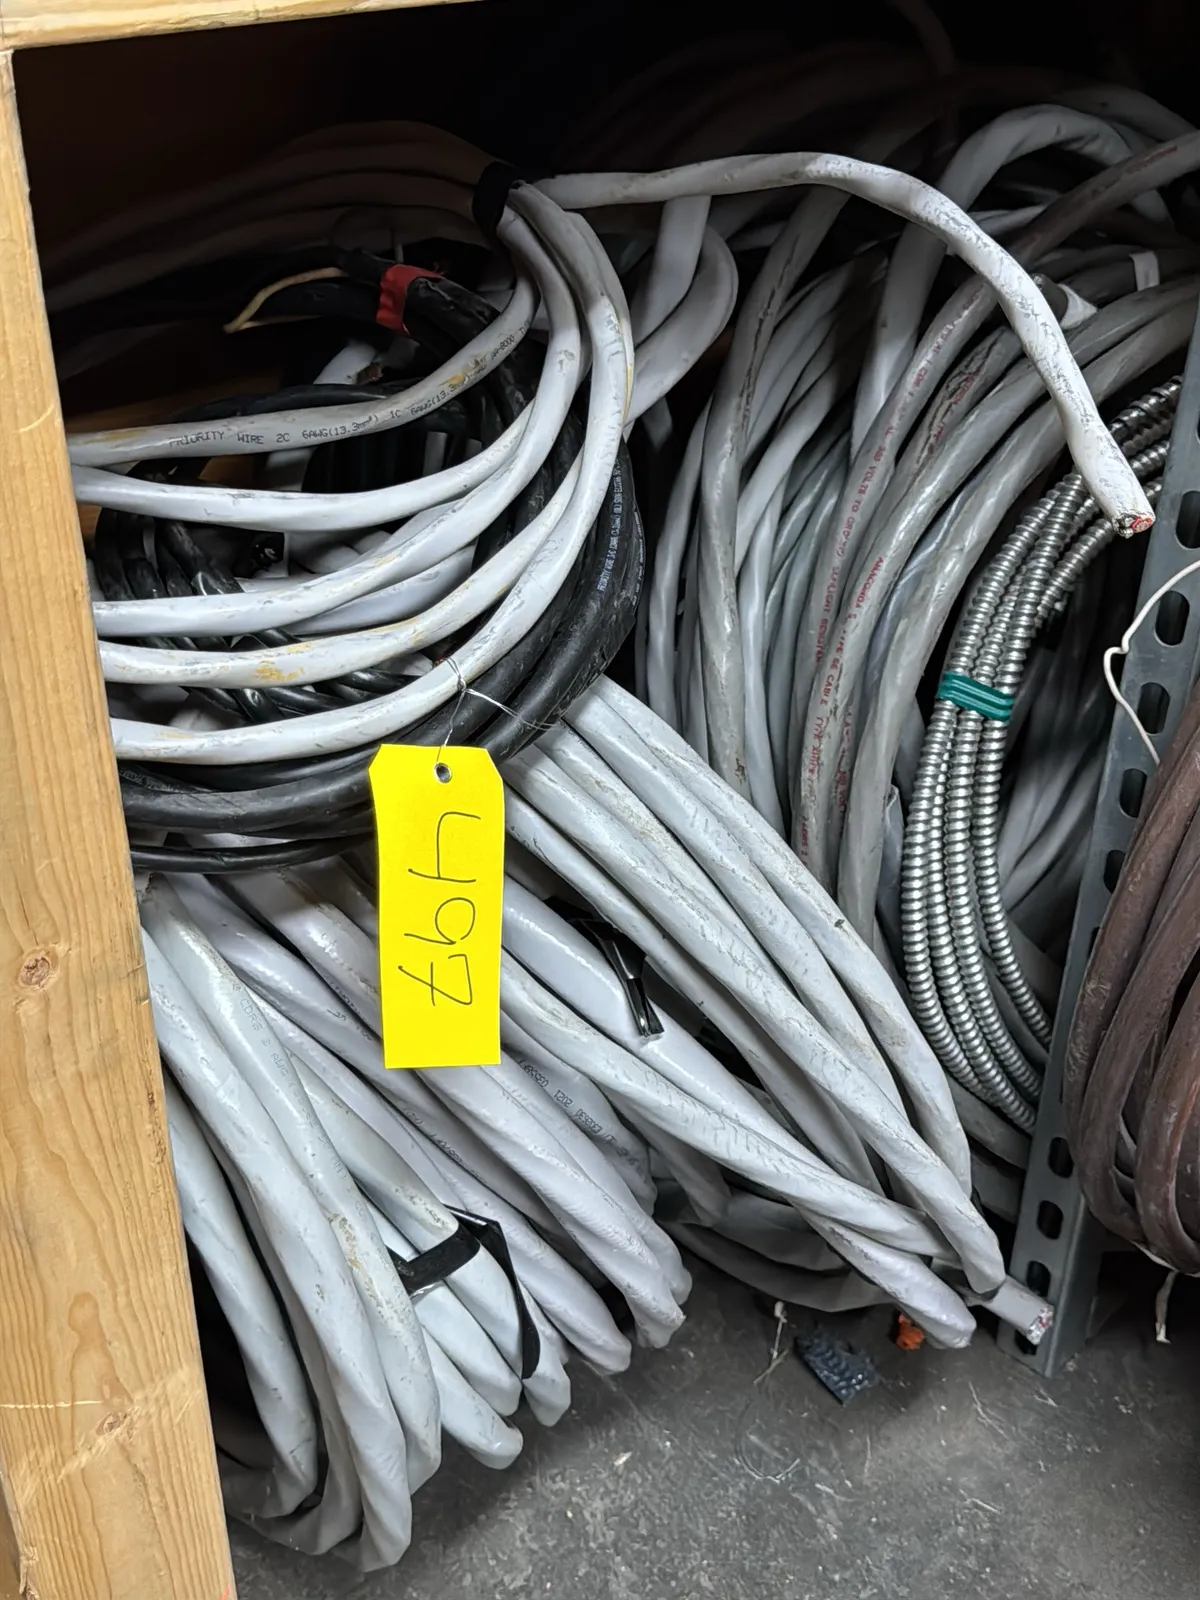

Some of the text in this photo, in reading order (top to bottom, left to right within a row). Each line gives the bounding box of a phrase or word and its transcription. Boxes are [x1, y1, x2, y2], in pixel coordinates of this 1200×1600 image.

[237, 433, 264, 445] WIRE
[276, 432, 291, 443] 2C
[390, 410, 401, 420] 1C
[852, 500, 861, 513] TO
[398, 811, 481, 1006] 497
[554, 1089, 573, 1107] 2021
